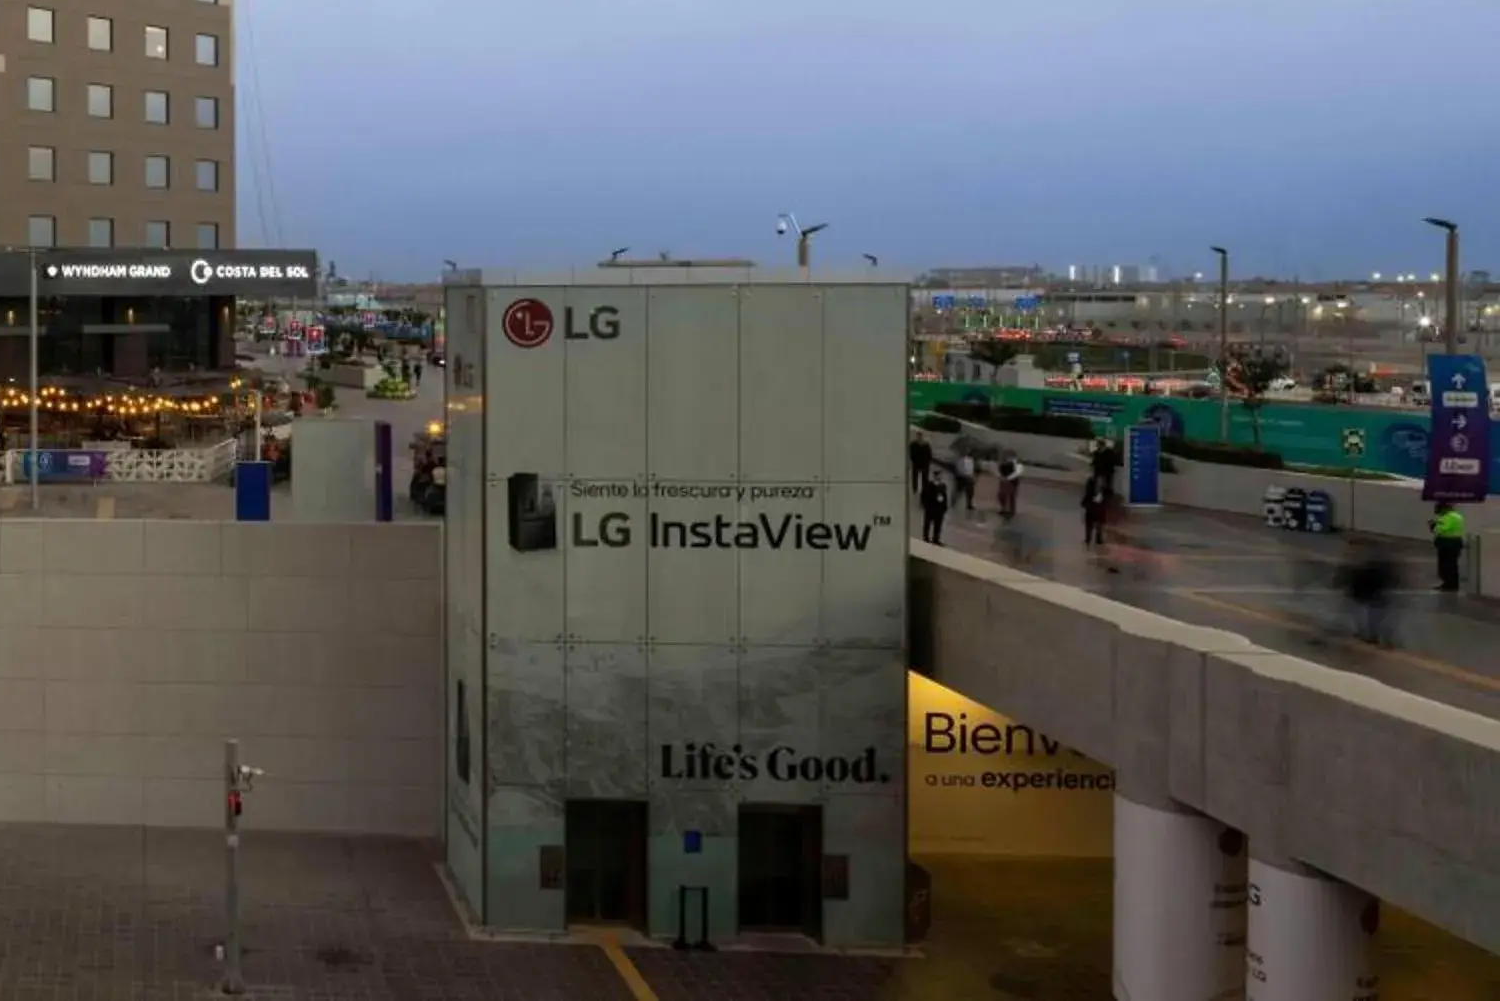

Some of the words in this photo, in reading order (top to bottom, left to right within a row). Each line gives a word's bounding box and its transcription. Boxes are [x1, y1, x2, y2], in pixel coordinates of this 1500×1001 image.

[61, 265, 126, 278] WYNDHAM
[129, 265, 171, 278] GRAND
[216, 265, 257, 278] COSTA
[259, 265, 283, 278] DEL
[286, 265, 309, 278] SOL
[564, 304, 620, 340] LG
[570, 482, 628, 498] Siente
[654, 482, 731, 499] frescura
[736, 485, 745, 502] y
[750, 484, 815, 502] pureza
[572, 512, 632, 548] LG
[925, 711, 1087, 758] Bienv
[660, 742, 759, 781] Life's
[766, 743, 891, 784] Good.
[925, 773, 938, 787] a
[941, 773, 976, 787] una
